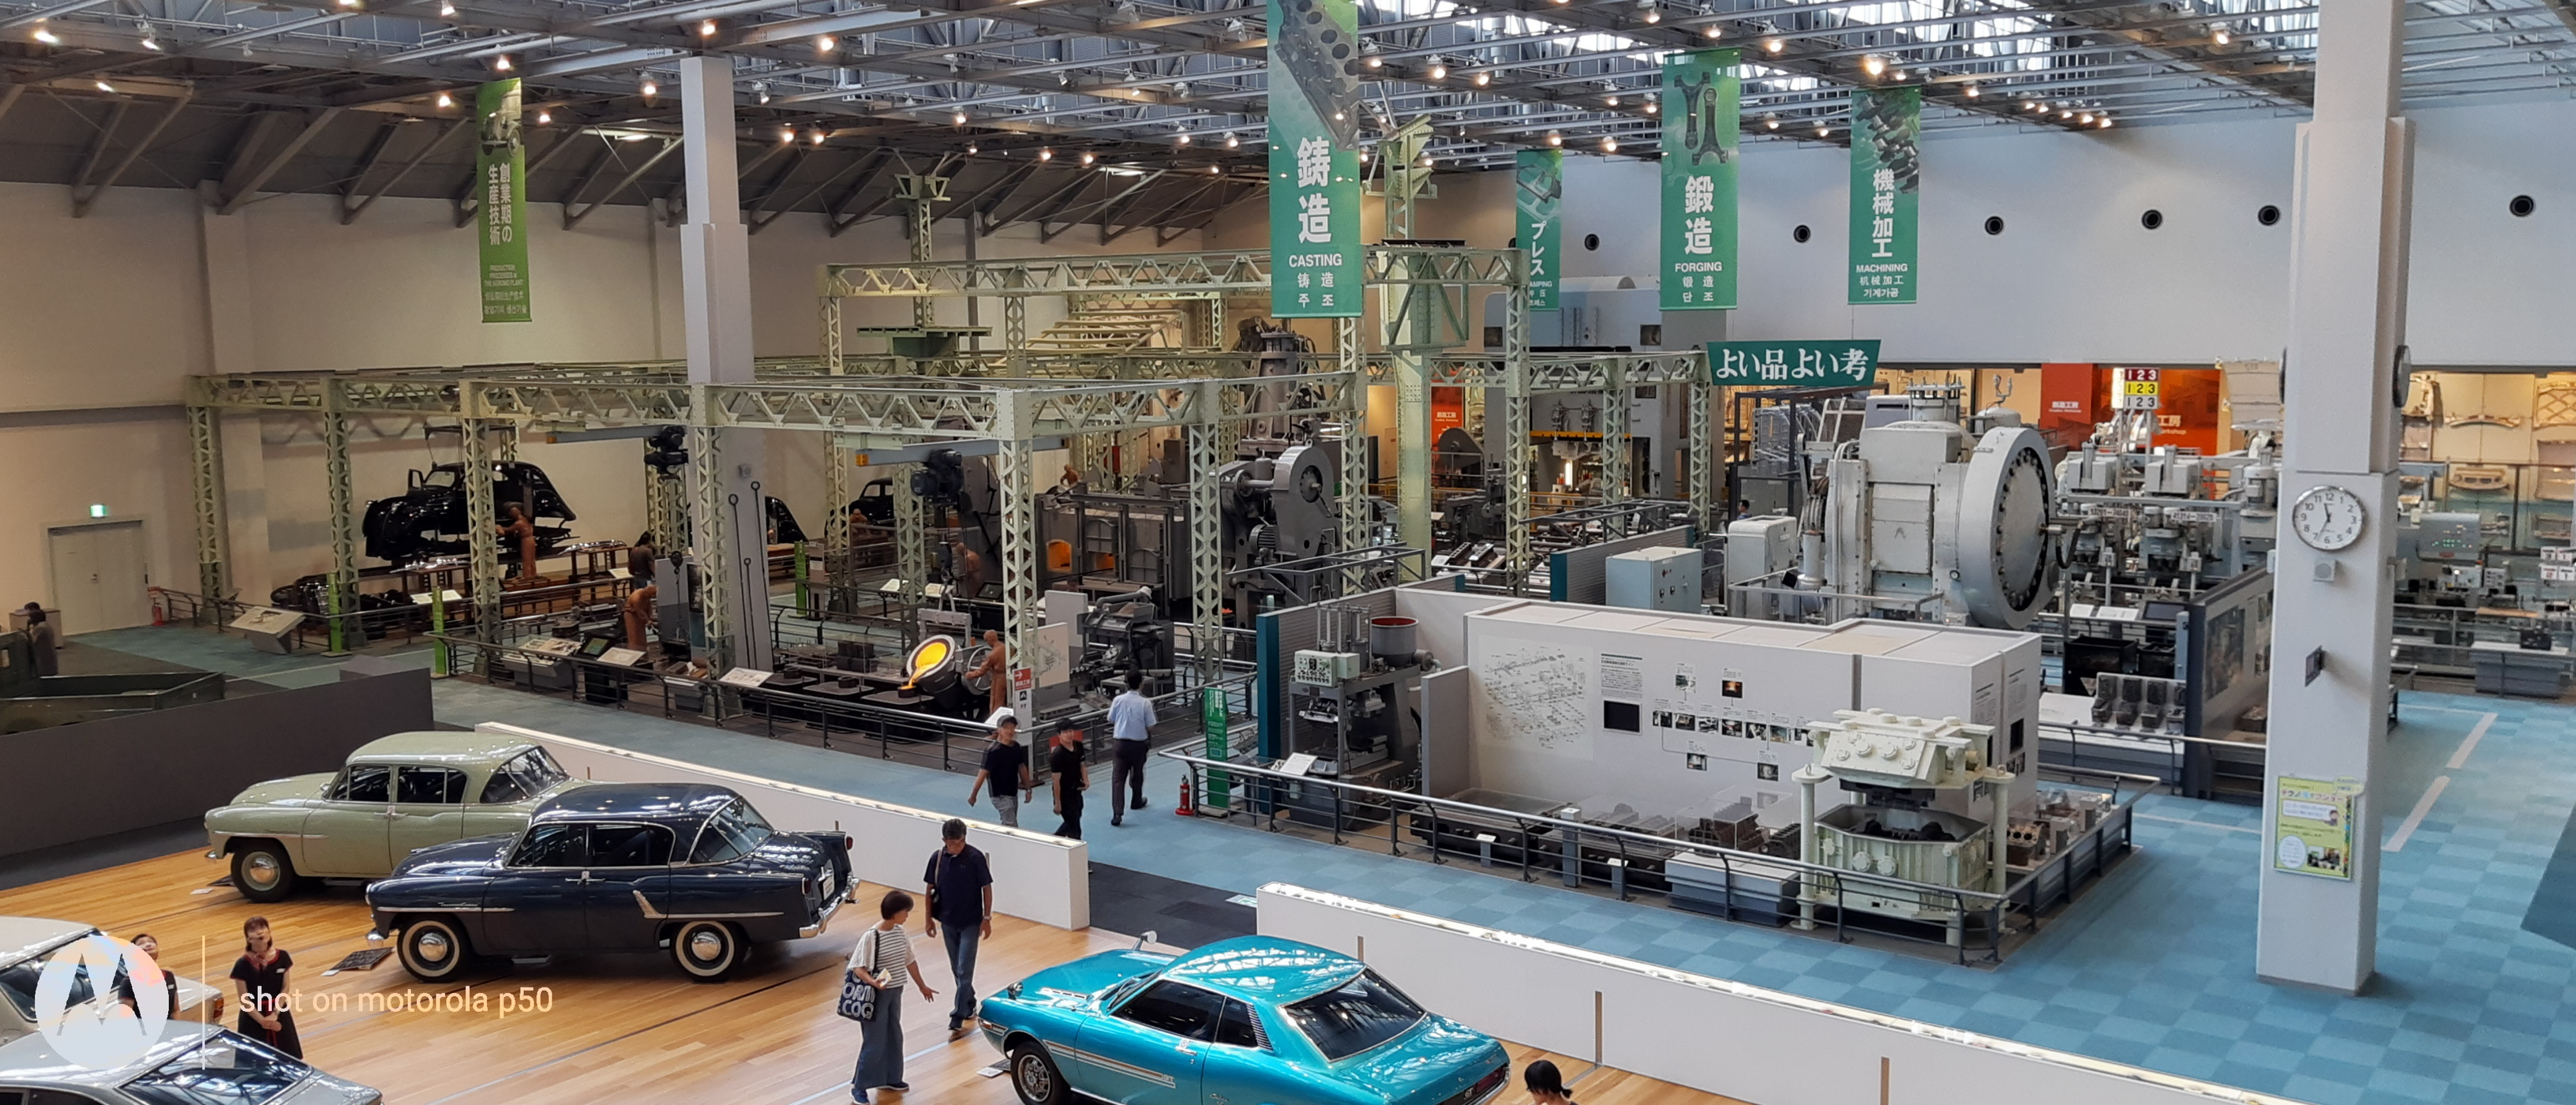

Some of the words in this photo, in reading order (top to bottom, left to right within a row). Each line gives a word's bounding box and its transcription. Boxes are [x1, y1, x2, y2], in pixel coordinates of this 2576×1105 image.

[488, 164, 500, 245] 生産技術
[500, 163, 513, 242] 創業期の
[1297, 136, 1331, 244] 鋳造
[1684, 175, 1714, 255] 鍛造
[1871, 168, 1895, 258] 機械加工
[1289, 253, 1342, 268] CASTING
[1530, 220, 1547, 276] プレス
[1675, 261, 1722, 272] FORGING
[1856, 264, 1908, 273] MACHINING
[1717, 348, 1869, 381] よい品よい考
[2136, 369, 2145, 380] 2
[2148, 369, 2157, 380] 3
[2136, 384, 2144, 394] 2
[2148, 384, 2155, 394] 3
[2136, 397, 2144, 407] 2
[2147, 397, 2155, 407] 3
